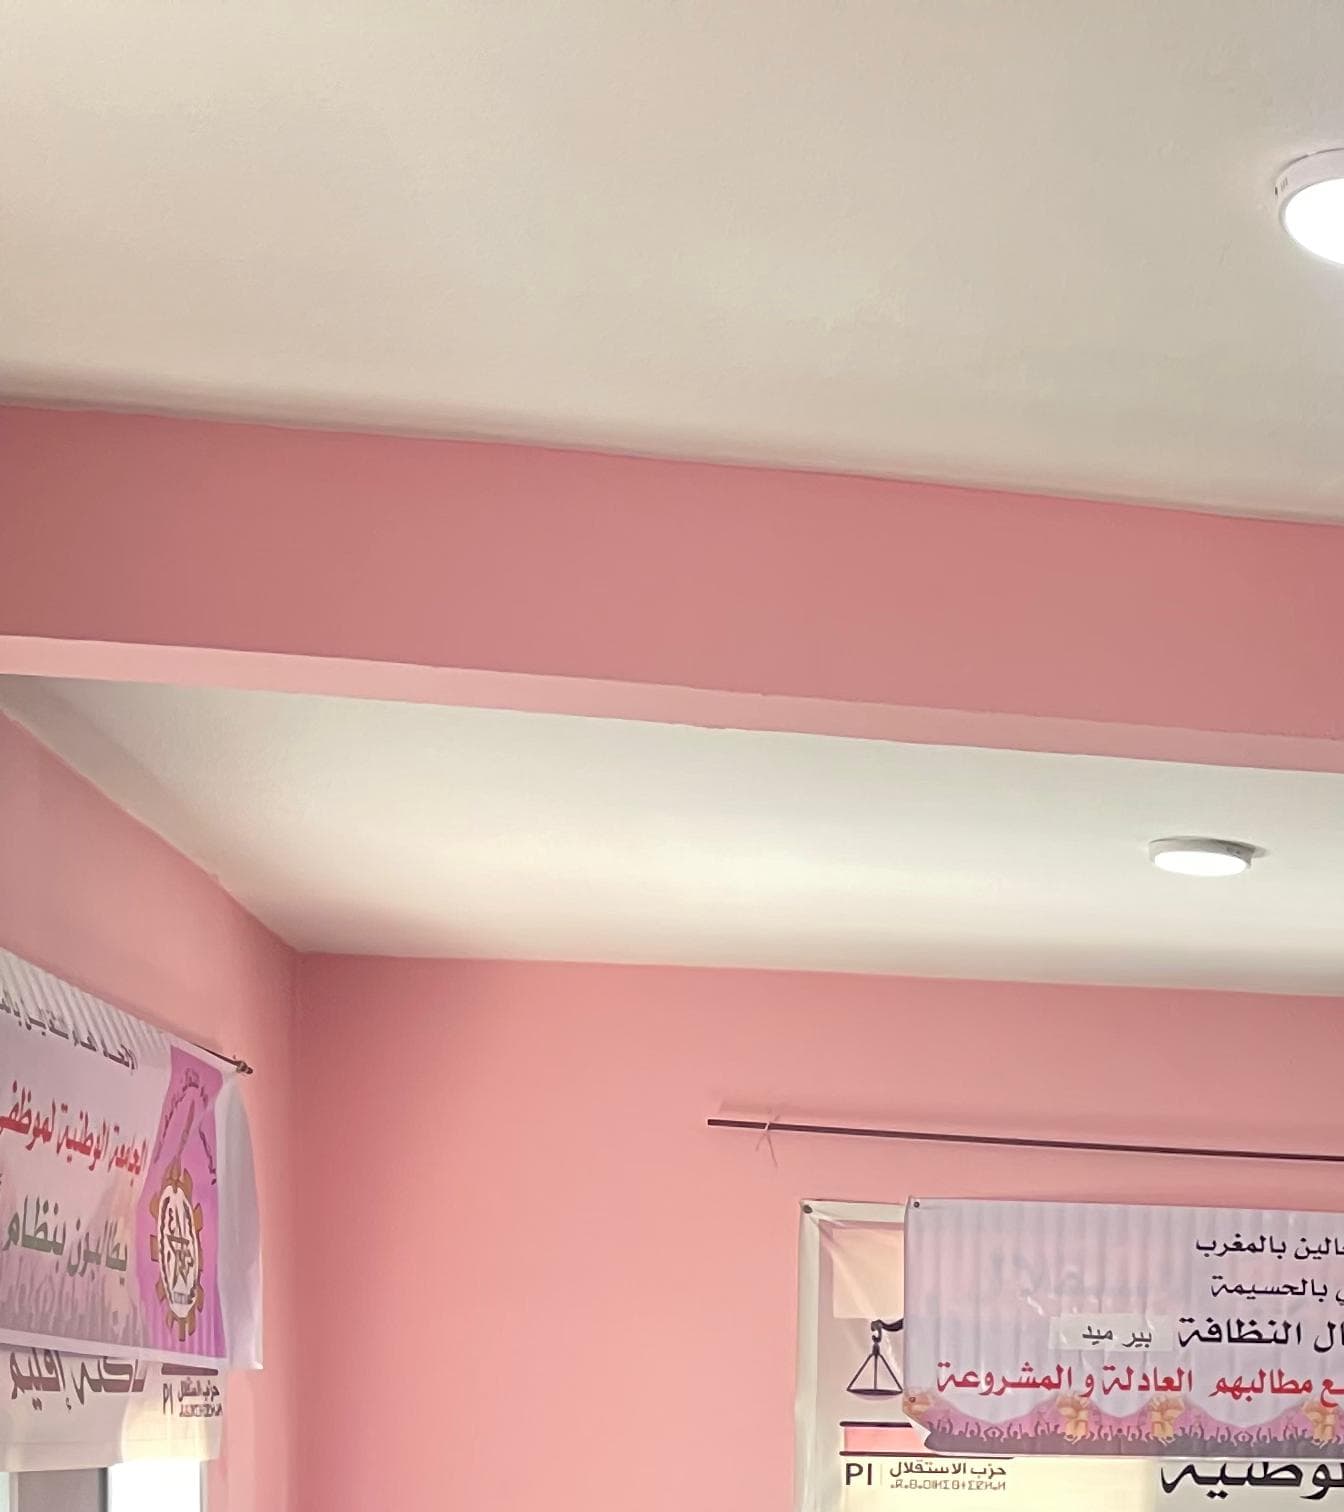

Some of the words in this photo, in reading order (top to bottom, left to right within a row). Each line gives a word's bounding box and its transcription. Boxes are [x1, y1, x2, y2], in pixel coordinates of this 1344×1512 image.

[0, 1080, 56, 1151] لموظف
[3, 1195, 67, 1273] بنظام
[1196, 1232, 1287, 1260] بالمغرب
[67, 1218, 128, 1286] يطالبون
[1211, 1275, 1328, 1301] بالحسيمة
[1082, 1325, 1113, 1346] ميد
[1122, 1327, 1152, 1348] بير
[1177, 1317, 1302, 1347] النظافة
[937, 1361, 1072, 1396] المشروعة
[1079, 1371, 1096, 1397] و
[1102, 1365, 1193, 1395] العادلة
[1208, 1368, 1313, 1402] مطالبهم
[845, 1462, 873, 1486] PI
[890, 1460, 967, 1478] الاستقلال
[970, 1462, 1007, 1479] حزب
